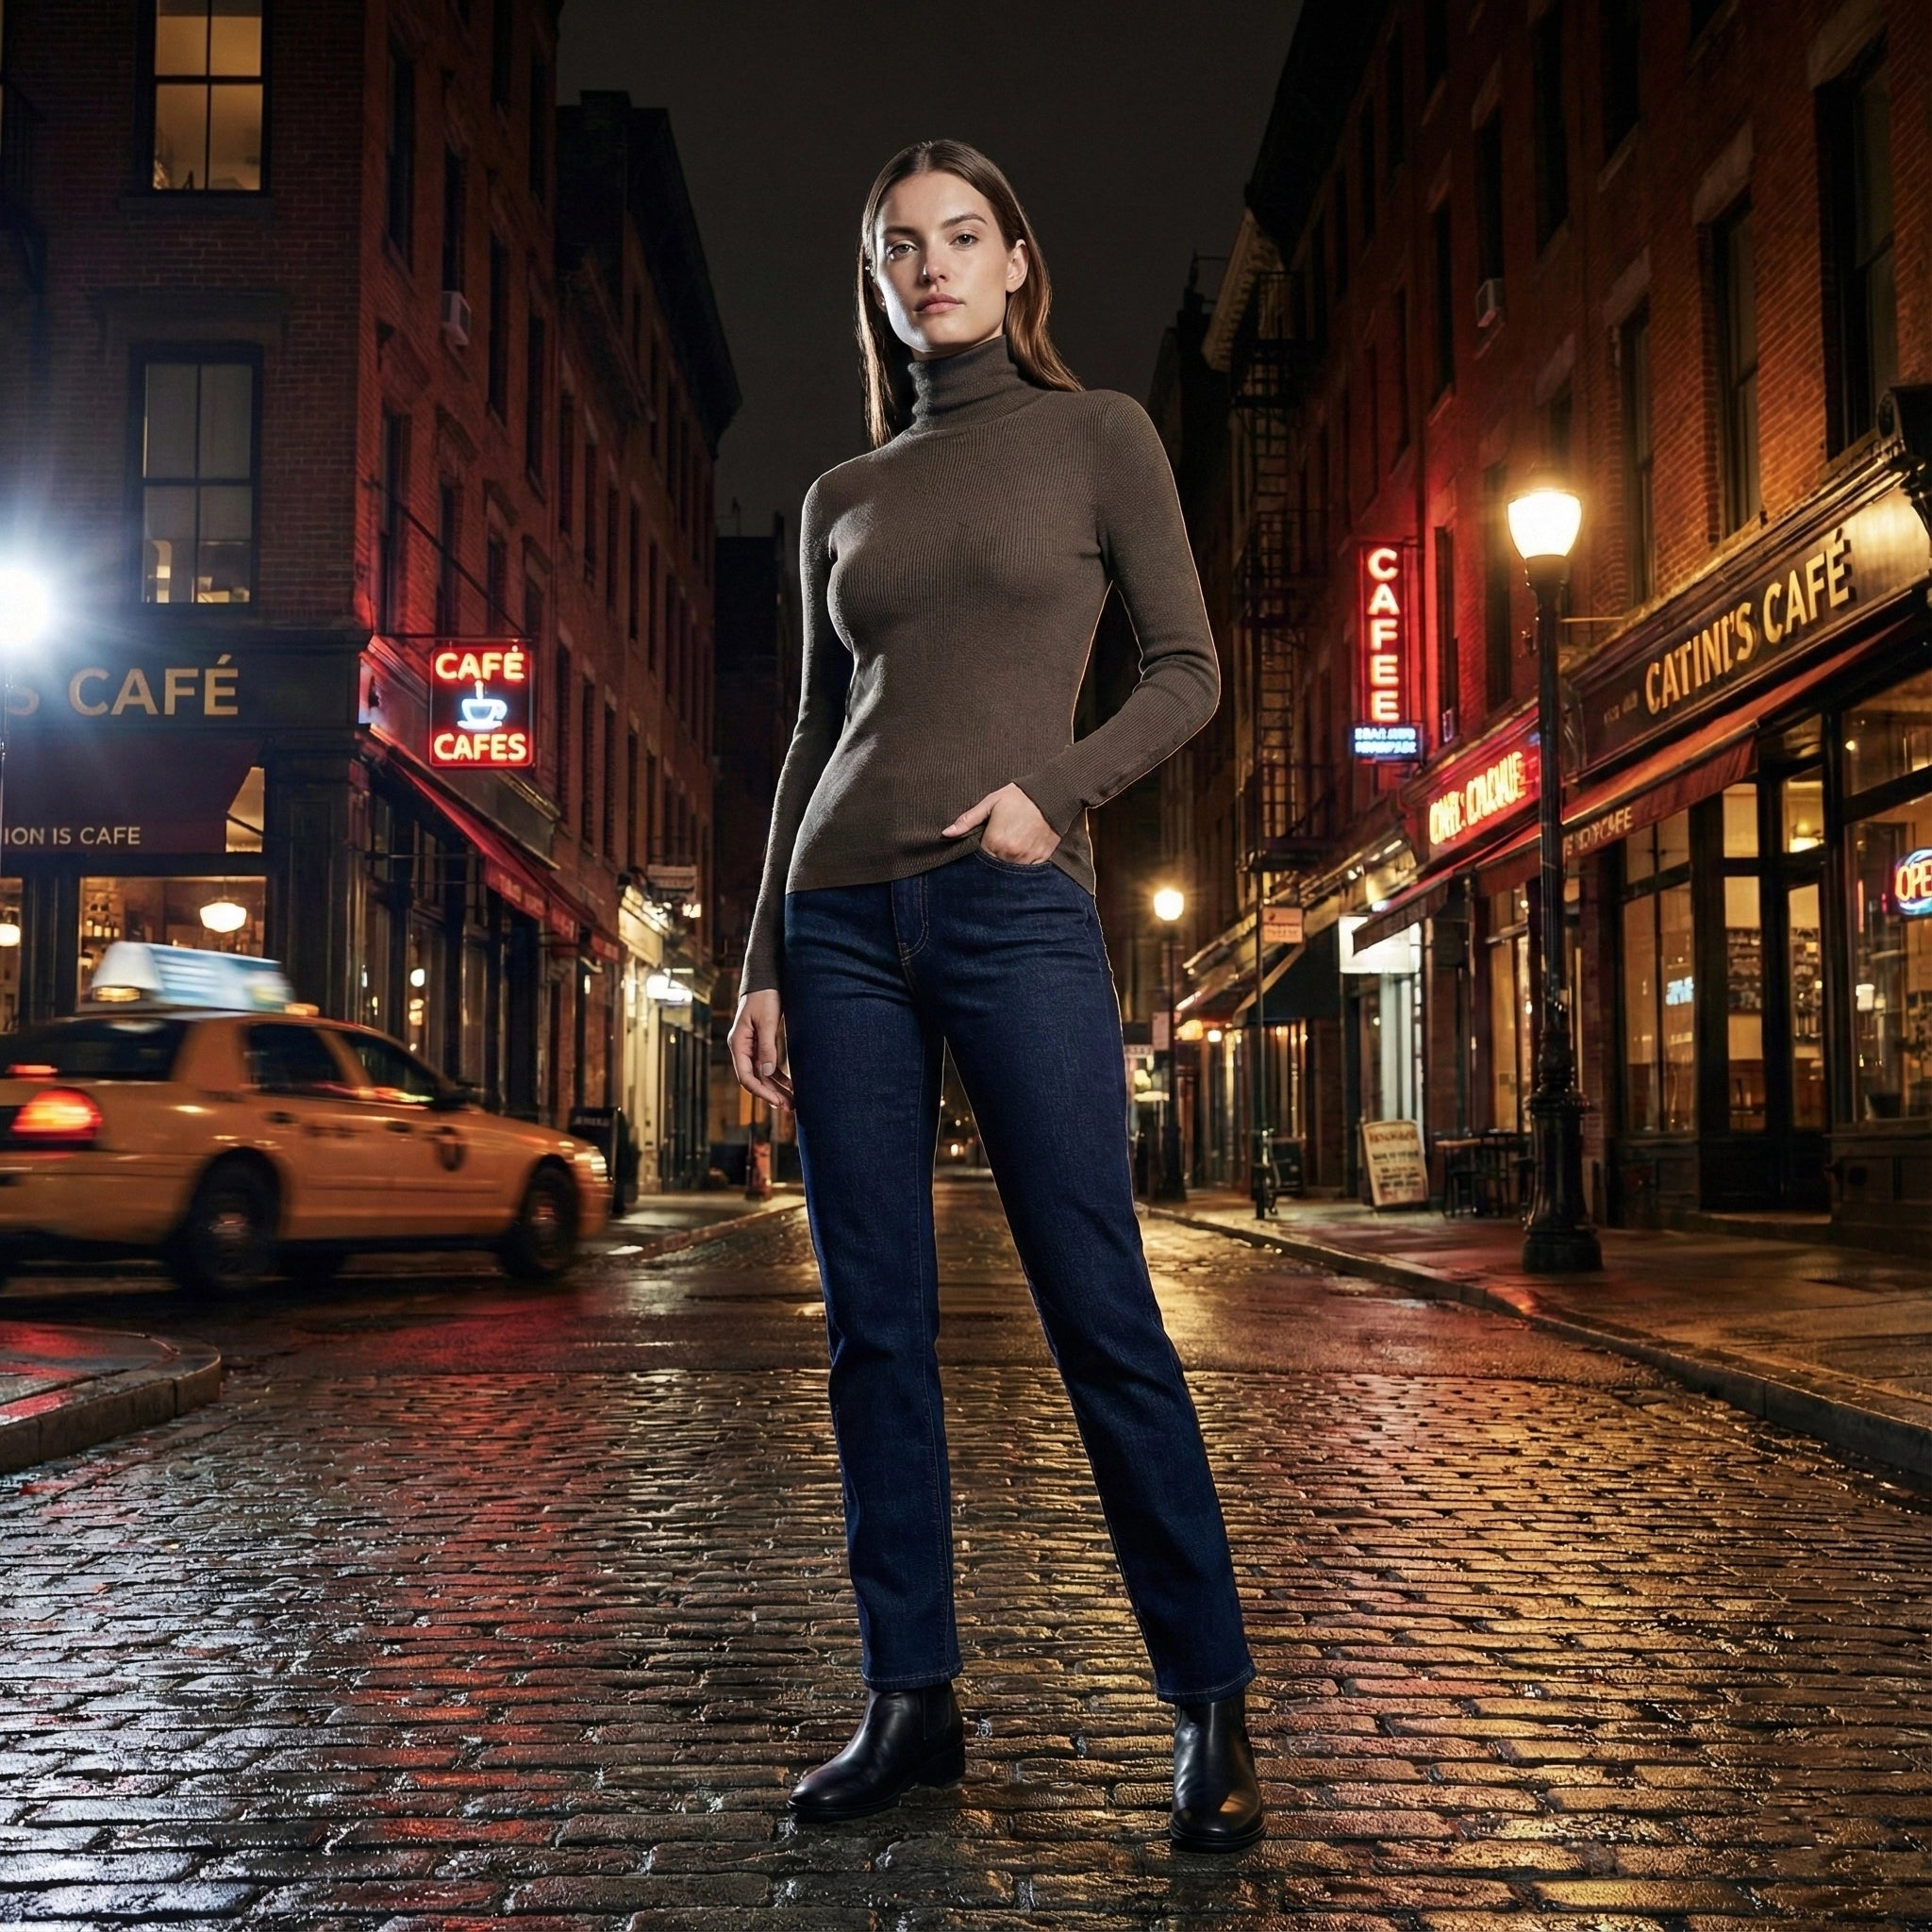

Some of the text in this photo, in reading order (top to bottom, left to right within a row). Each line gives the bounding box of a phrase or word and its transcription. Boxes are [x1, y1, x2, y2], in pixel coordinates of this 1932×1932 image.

[1368, 547, 1400, 722] CAFEE
[1645, 528, 1851, 715] CATINI'S CAFÉ
[68, 654, 239, 716] CAFÉ
[433, 732, 527, 761] CAFES
[52, 826, 72, 845] IS
[79, 826, 141, 845] CAFE
